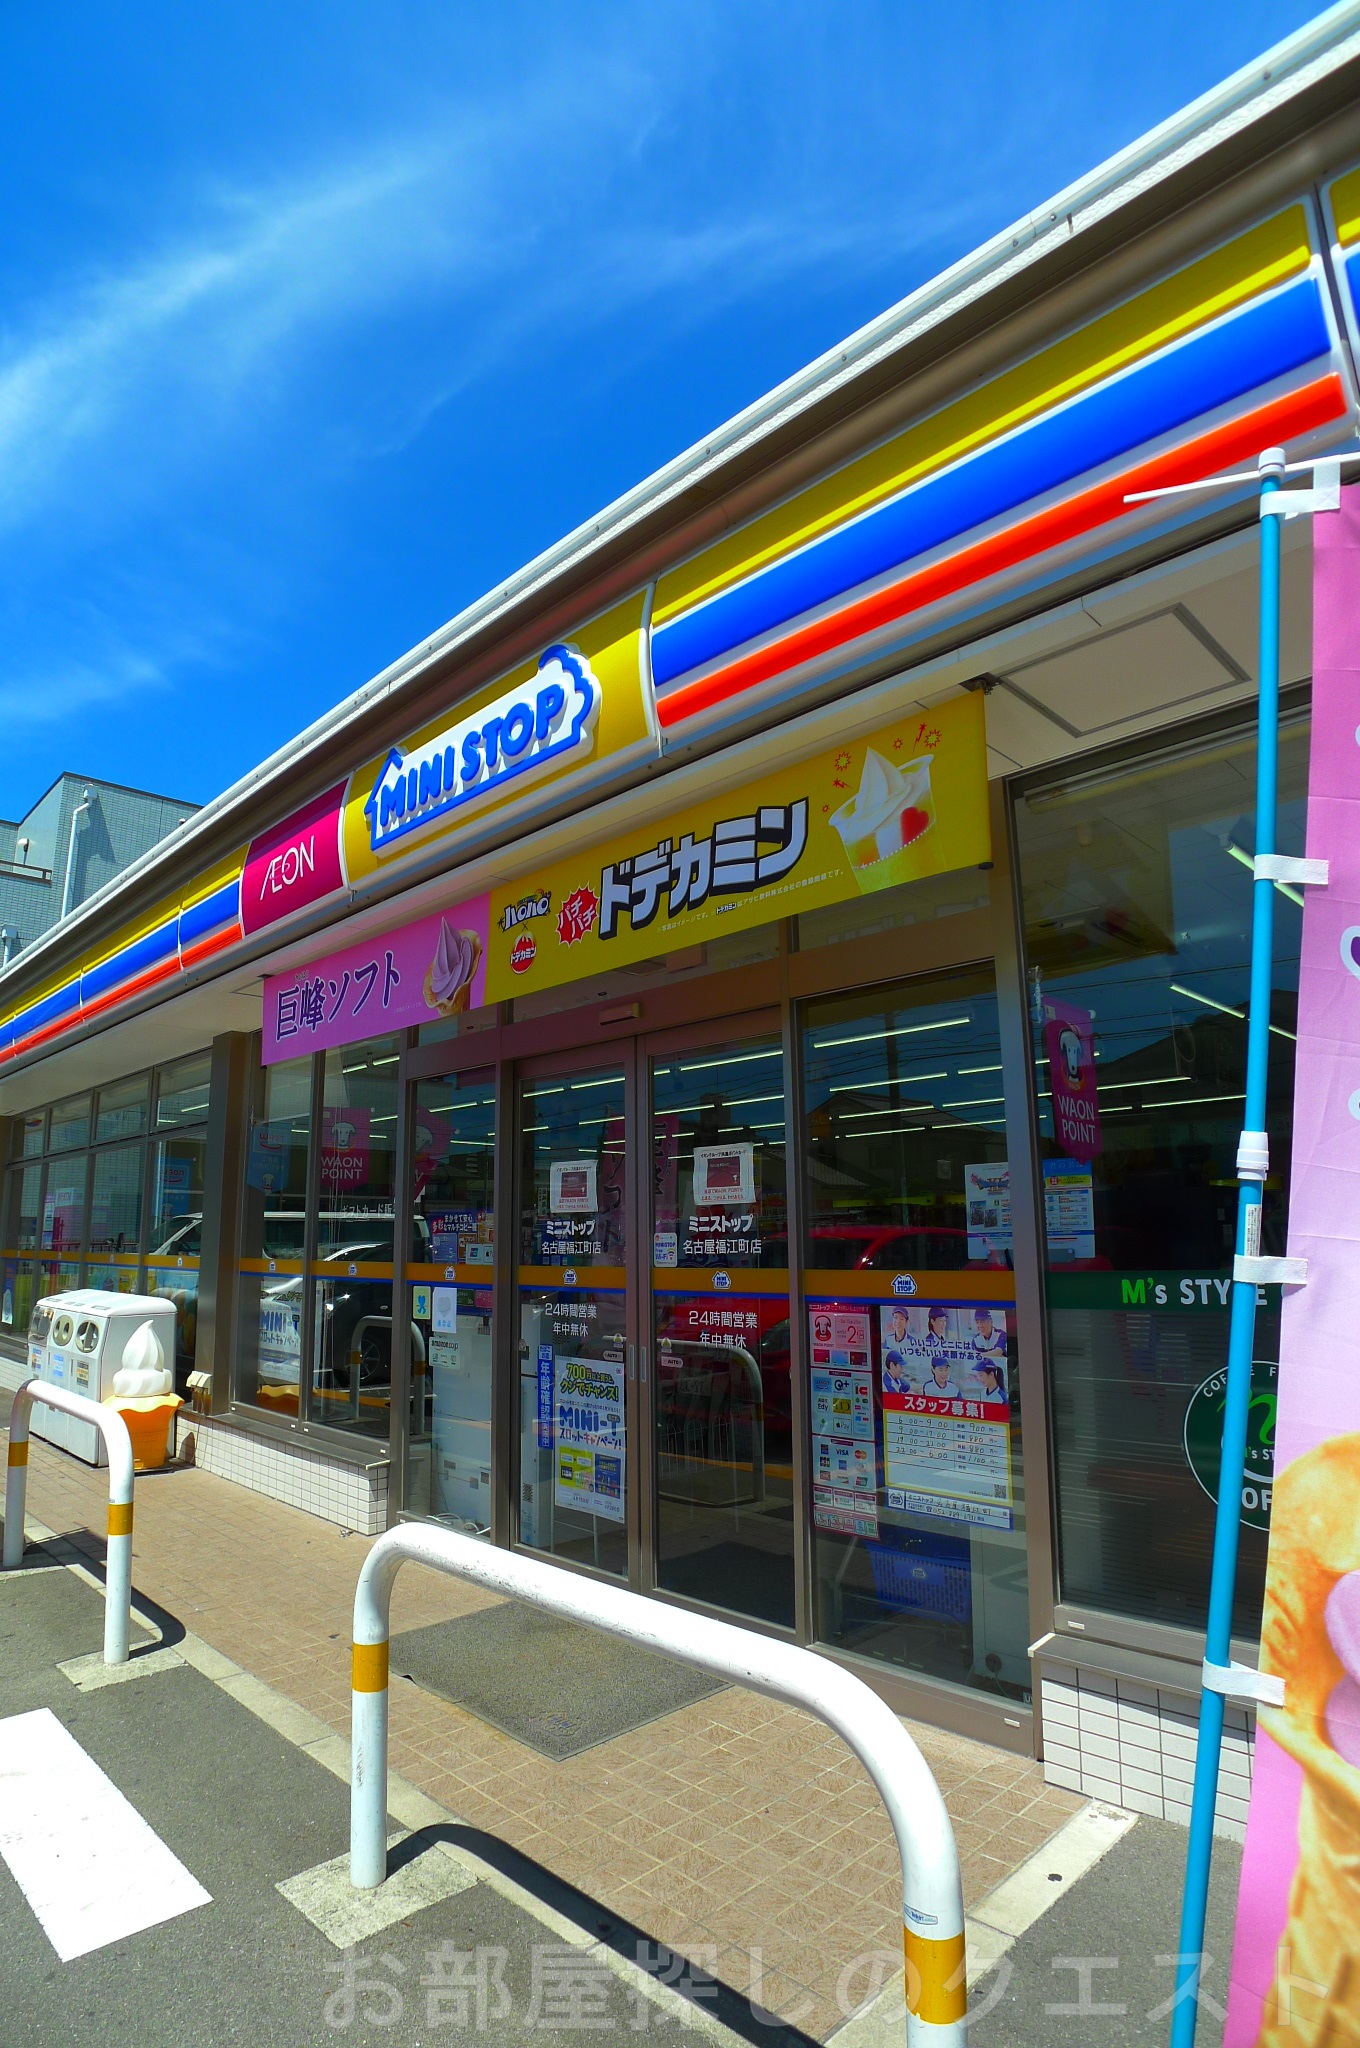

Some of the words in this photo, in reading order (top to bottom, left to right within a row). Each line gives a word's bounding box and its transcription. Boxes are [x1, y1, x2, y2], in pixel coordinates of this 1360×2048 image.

[380, 745, 455, 828] MINI
[461, 684, 565, 781] STOP
[599, 797, 809, 940] ドデカミン
[560, 895, 583, 930] パチ
[571, 904, 595, 939] パチ
[510, 946, 537, 965] ドデカミン
[276, 950, 401, 1042] 巨峰ソフト
[1057, 1094, 1094, 1121] WAON
[1062, 1118, 1096, 1144] POINT
[321, 1156, 363, 1168] WAON
[321, 1169, 363, 1180] POINT
[546, 1219, 596, 1236] ミニストップ
[689, 1213, 754, 1233] ミニストップ
[541, 1240, 602, 1255] 名古屋福江町店
[683, 1238, 762, 1254] 名古屋福江町店
[1121, 1279, 1168, 1305] M's
[1180, 1279, 1268, 1305] STYE
[545, 1303, 597, 1319] 24時間営業
[688, 1310, 758, 1329] 24時間営業
[552, 1321, 589, 1337] 年中無休
[699, 1331, 747, 1350] 年中無休
[910, 1338, 974, 1350] いいコンビニには、
[900, 1347, 987, 1360] いつも、いい笑顔がある。
[560, 1378, 618, 1402] クジでチャンス!
[904, 1396, 984, 1418] スタッフ募集!
[560, 1427, 622, 1450] スロットキャンペーン!
